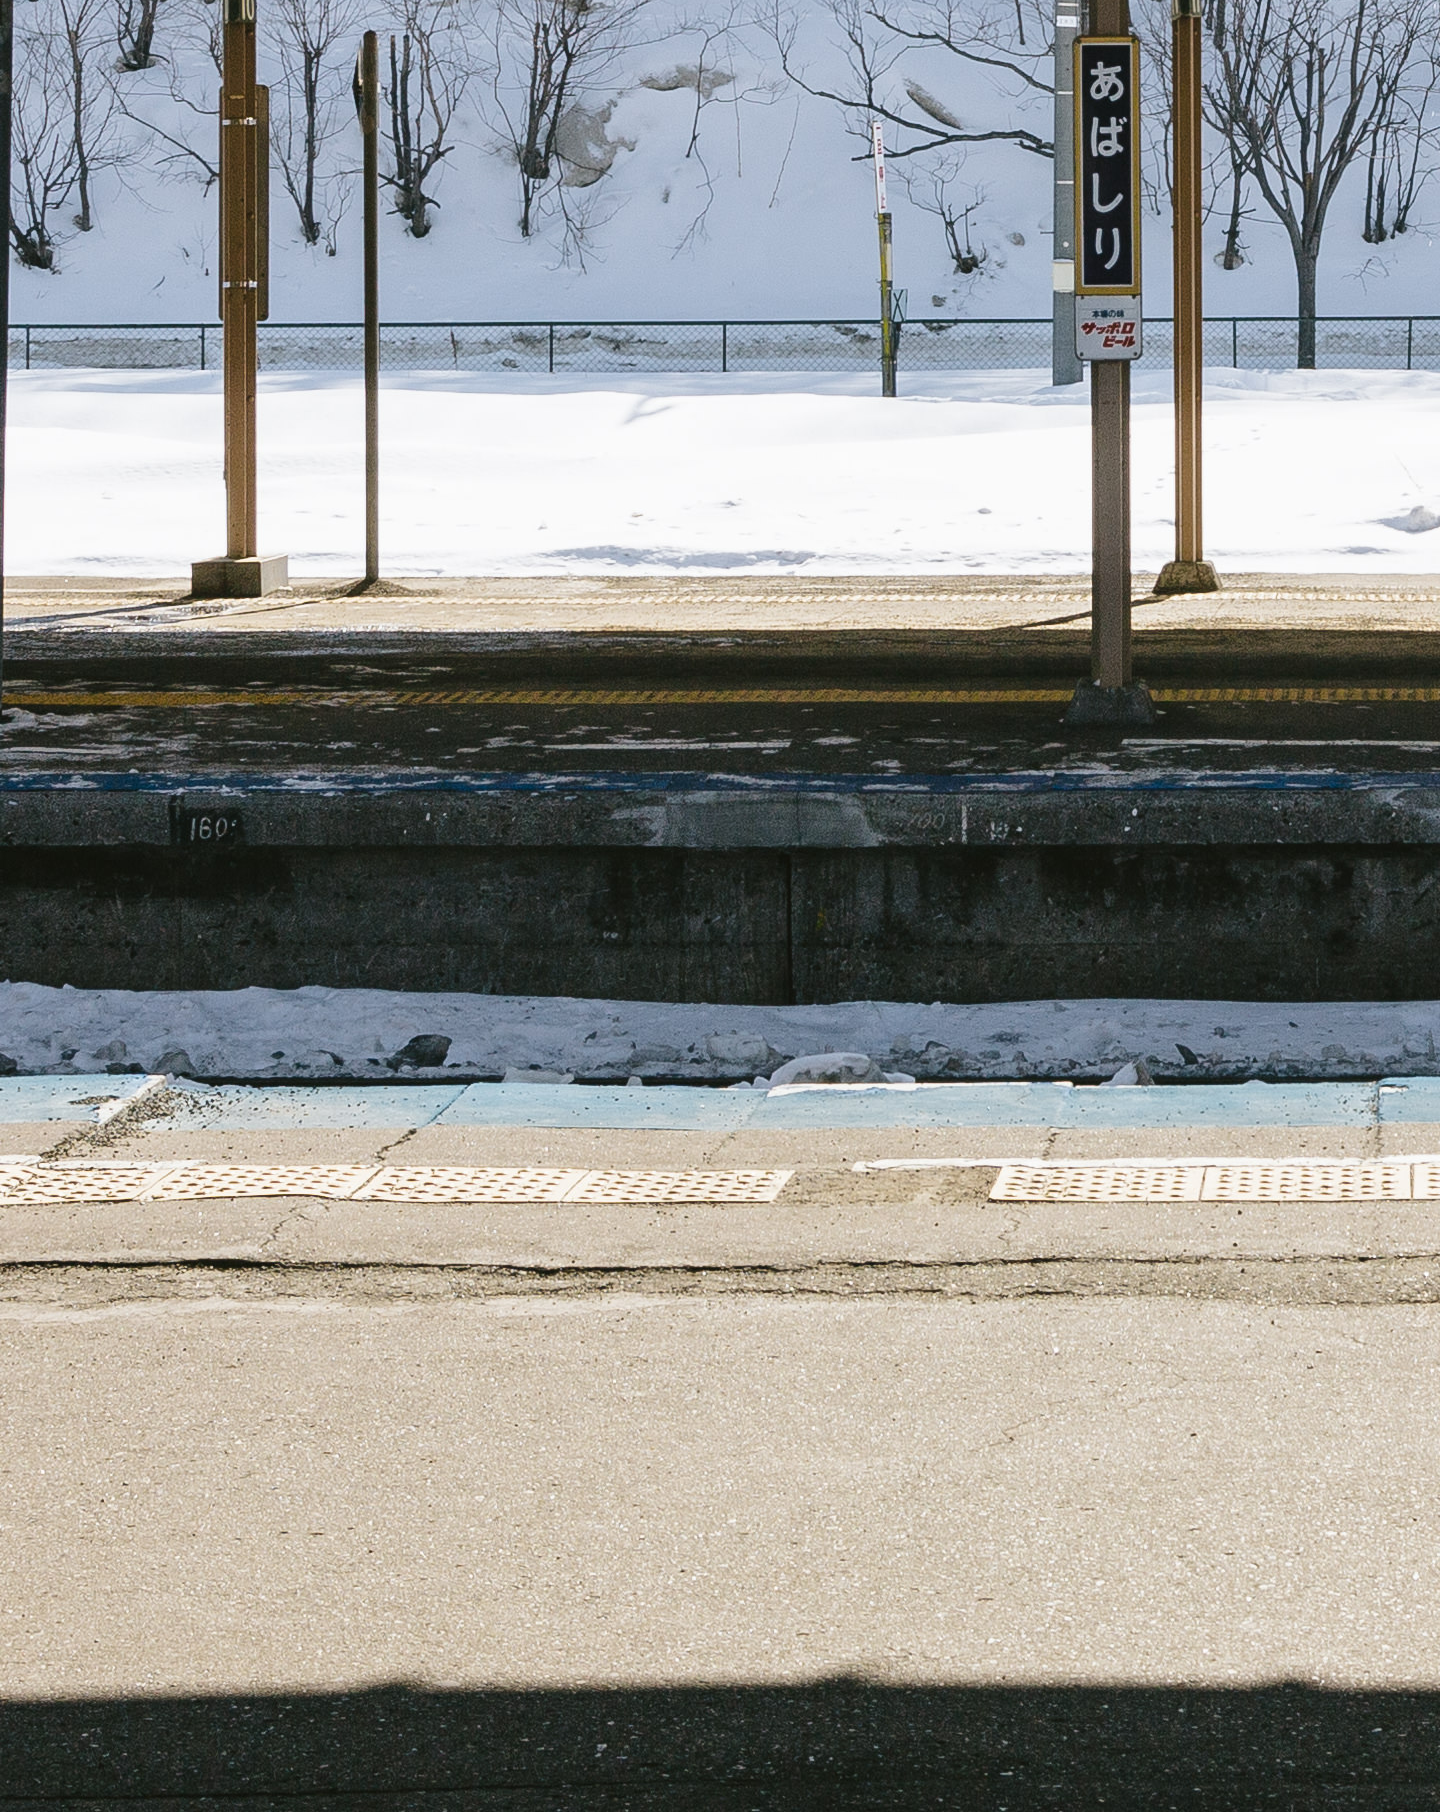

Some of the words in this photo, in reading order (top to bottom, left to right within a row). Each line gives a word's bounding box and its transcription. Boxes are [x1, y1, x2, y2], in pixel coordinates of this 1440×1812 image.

[1089, 61, 1128, 271] あばしり
[1080, 321, 1137, 335] サッポロ
[1102, 335, 1136, 348] ビール
